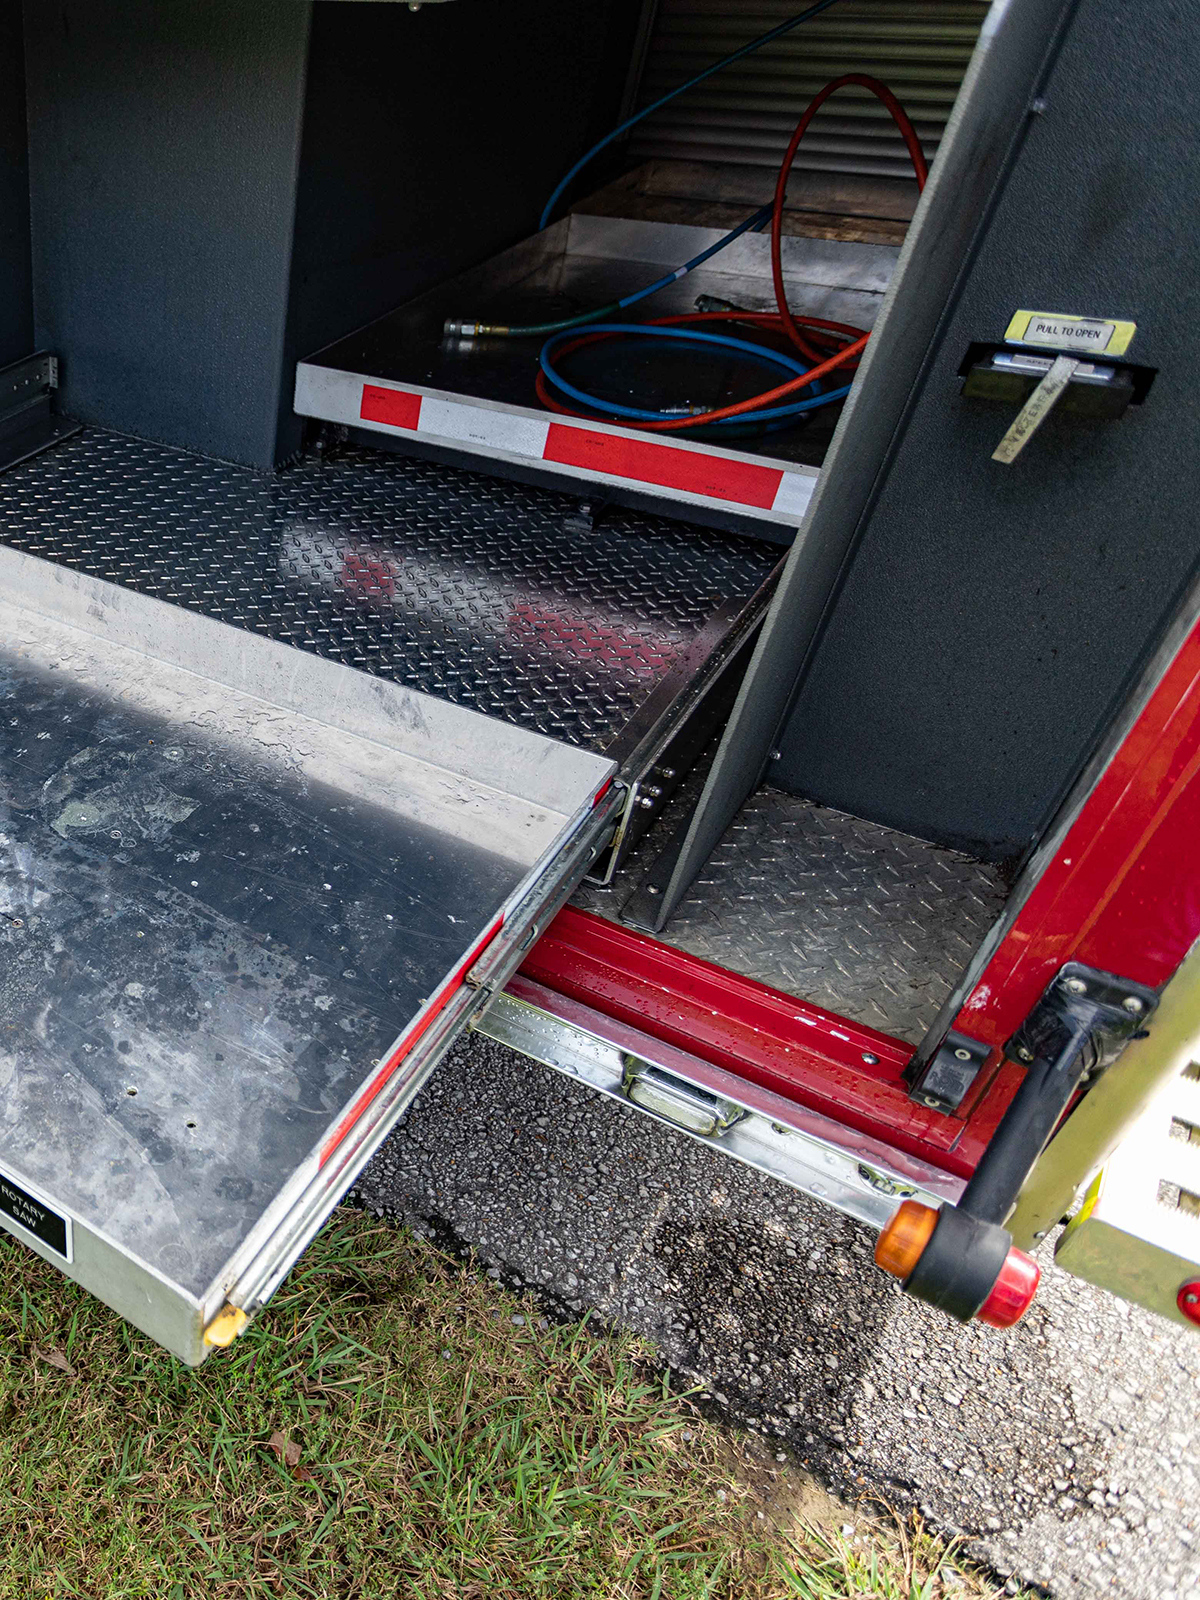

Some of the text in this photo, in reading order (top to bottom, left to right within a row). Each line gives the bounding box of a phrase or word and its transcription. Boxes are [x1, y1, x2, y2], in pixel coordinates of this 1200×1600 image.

[1036, 324, 1101, 339] PULL TO OPEN
[1, 1185, 46, 1221] ROTARY
[12, 1205, 36, 1228] SAW
